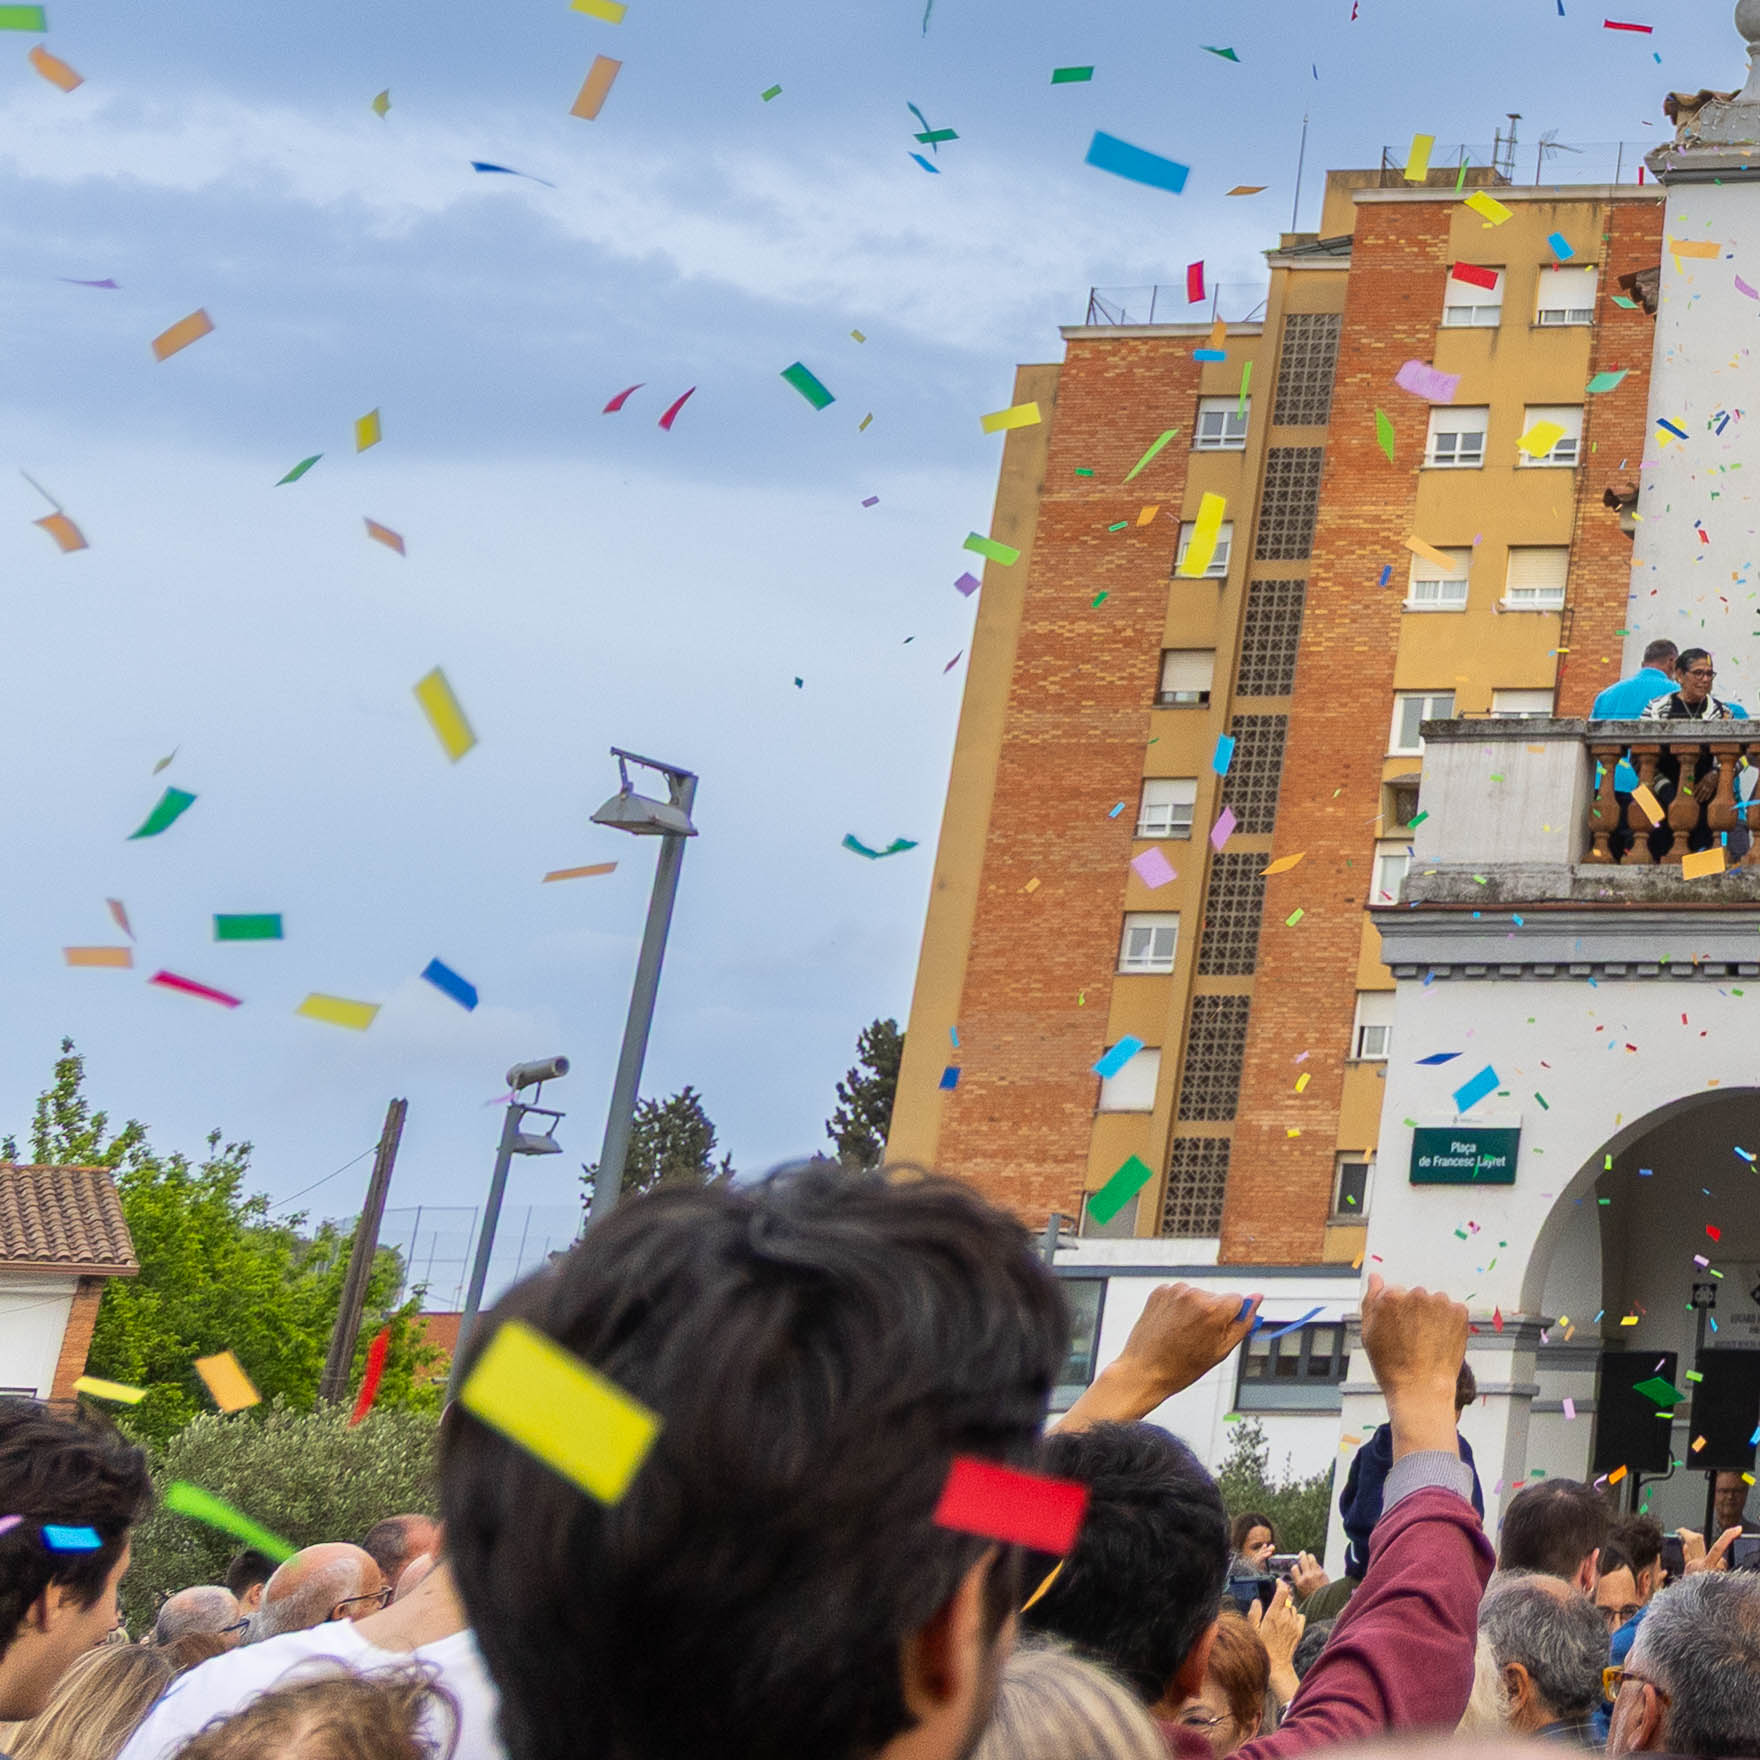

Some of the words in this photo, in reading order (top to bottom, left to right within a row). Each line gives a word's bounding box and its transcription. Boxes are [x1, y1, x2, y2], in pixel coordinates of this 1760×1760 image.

[1450, 1141, 1477, 1155] Plaça
[1418, 1156, 1431, 1167] de
[1433, 1155, 1474, 1167] Francesc
